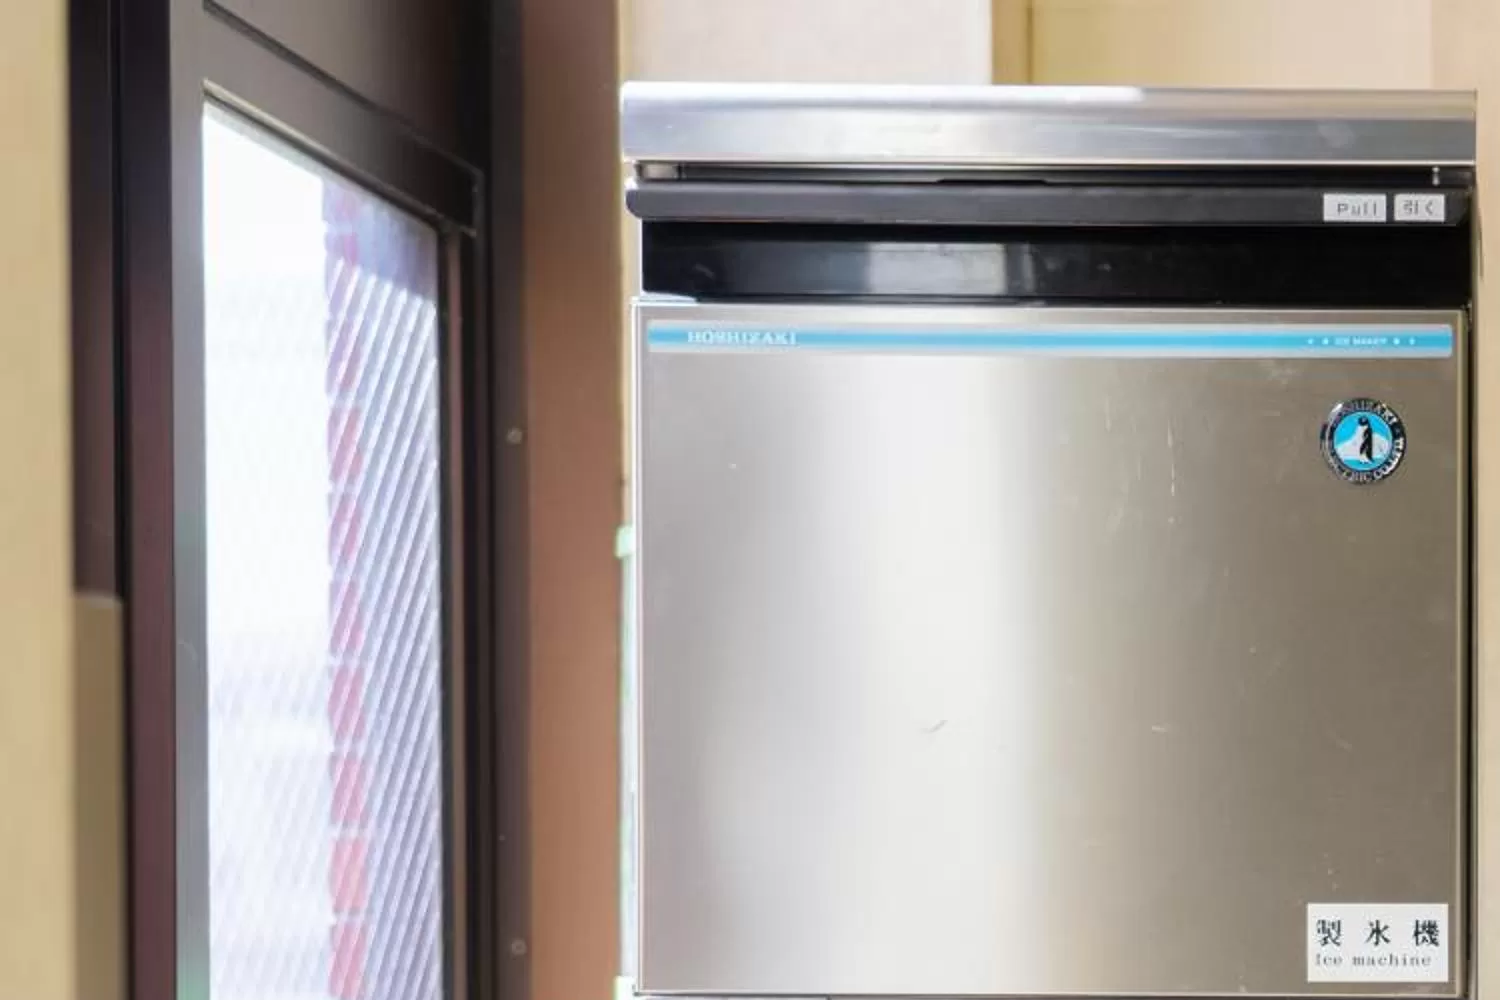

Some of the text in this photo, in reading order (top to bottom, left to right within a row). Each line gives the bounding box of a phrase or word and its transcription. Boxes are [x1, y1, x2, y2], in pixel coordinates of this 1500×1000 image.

[1337, 202, 1377, 216] Pull
[1402, 199, 1434, 215] 引く
[687, 331, 797, 345] HOSHIZAKI
[1315, 918, 1440, 947] 製氷機
[1316, 953, 1432, 966] Ice machine
